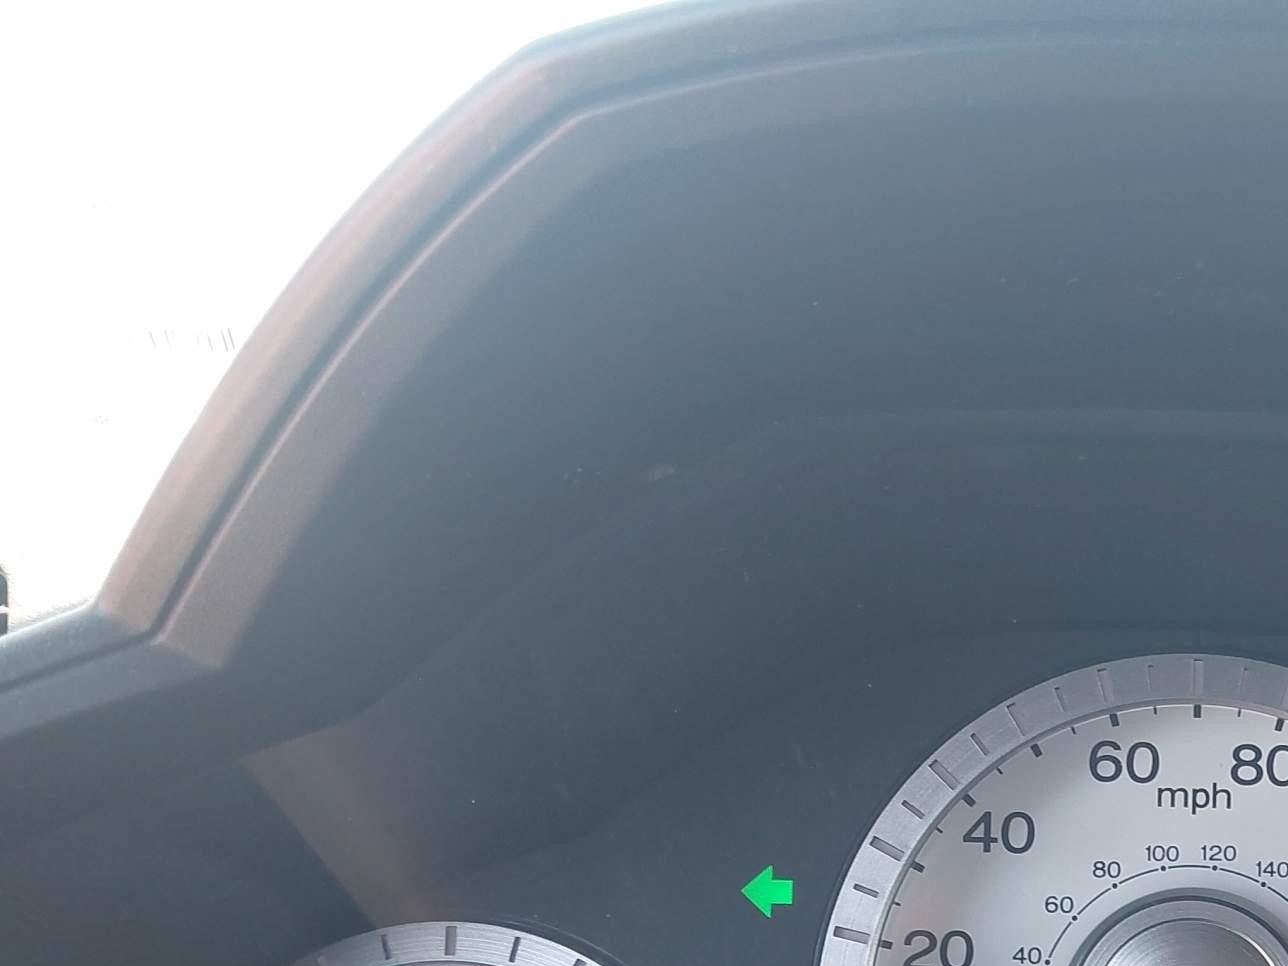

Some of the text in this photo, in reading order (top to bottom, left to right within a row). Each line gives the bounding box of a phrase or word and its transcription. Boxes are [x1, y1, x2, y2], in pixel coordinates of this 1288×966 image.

[1089, 741, 1159, 782] 60
[1156, 784, 1231, 813] mph
[962, 812, 1035, 852] 40
[1146, 846, 1178, 861] 100
[1201, 846, 1236, 861] 120
[1092, 862, 1120, 878] 80
[1256, 862, 1288, 877] 140
[1045, 897, 1073, 913] 60
[1012, 948, 1040, 964] 40
